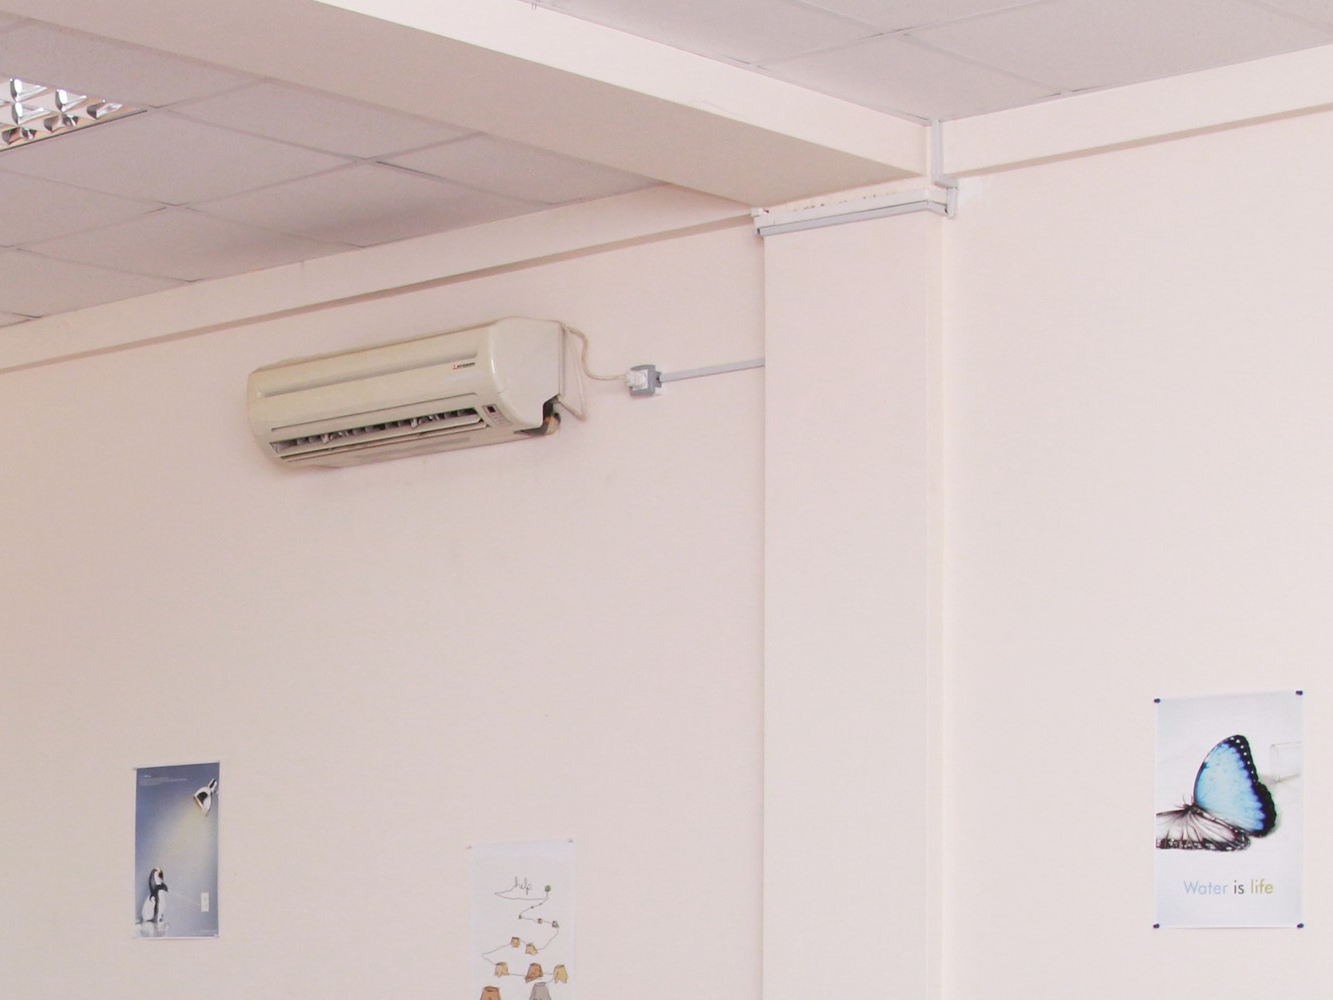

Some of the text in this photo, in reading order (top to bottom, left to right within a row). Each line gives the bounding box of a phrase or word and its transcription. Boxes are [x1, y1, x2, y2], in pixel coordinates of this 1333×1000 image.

[514, 876, 532, 896] help
[1183, 878, 1274, 895] Water is life
